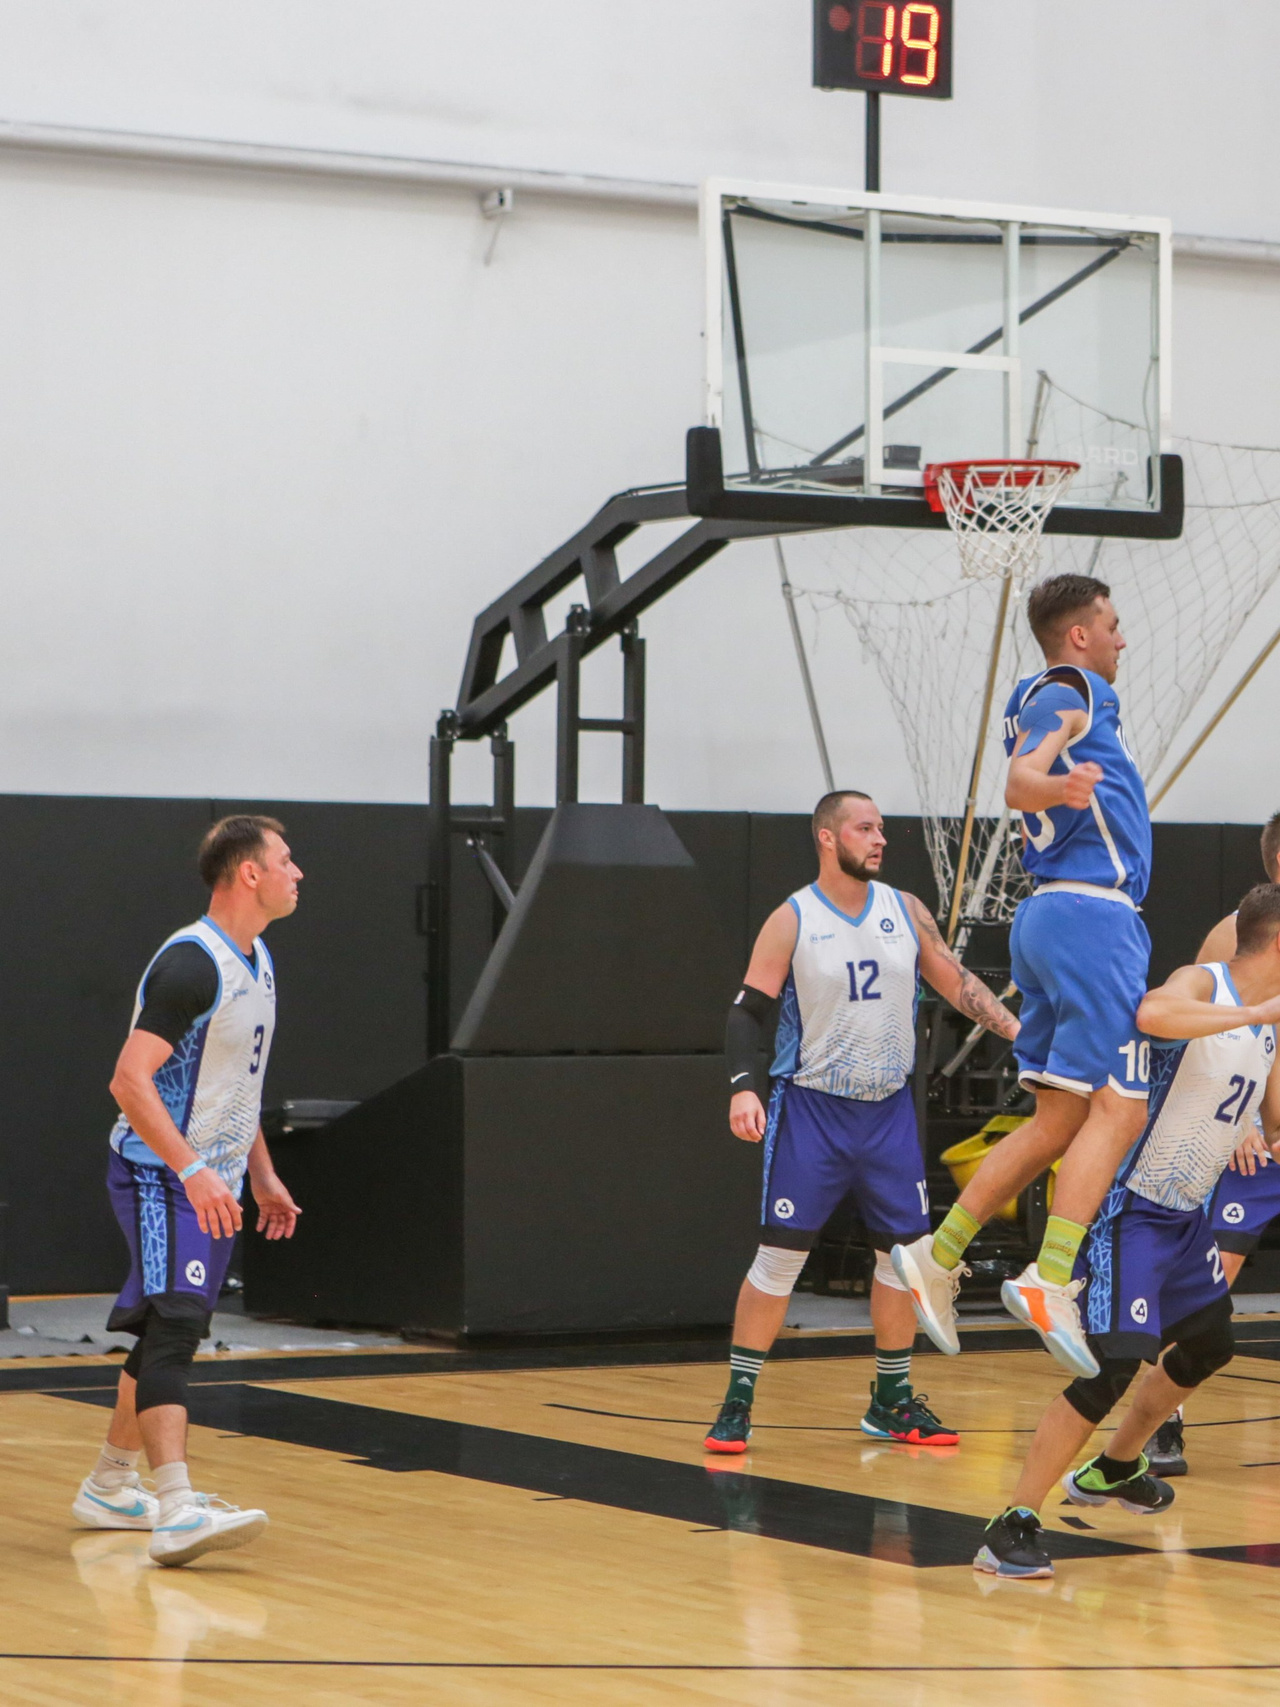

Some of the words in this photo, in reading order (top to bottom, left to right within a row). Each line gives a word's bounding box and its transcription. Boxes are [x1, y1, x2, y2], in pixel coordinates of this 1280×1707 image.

[881, 3, 939, 86] 19
[846, 959, 882, 1002] 12
[249, 1024, 265, 1076] 3
[1118, 1040, 1150, 1083] 10
[1213, 1073, 1257, 1127] 21
